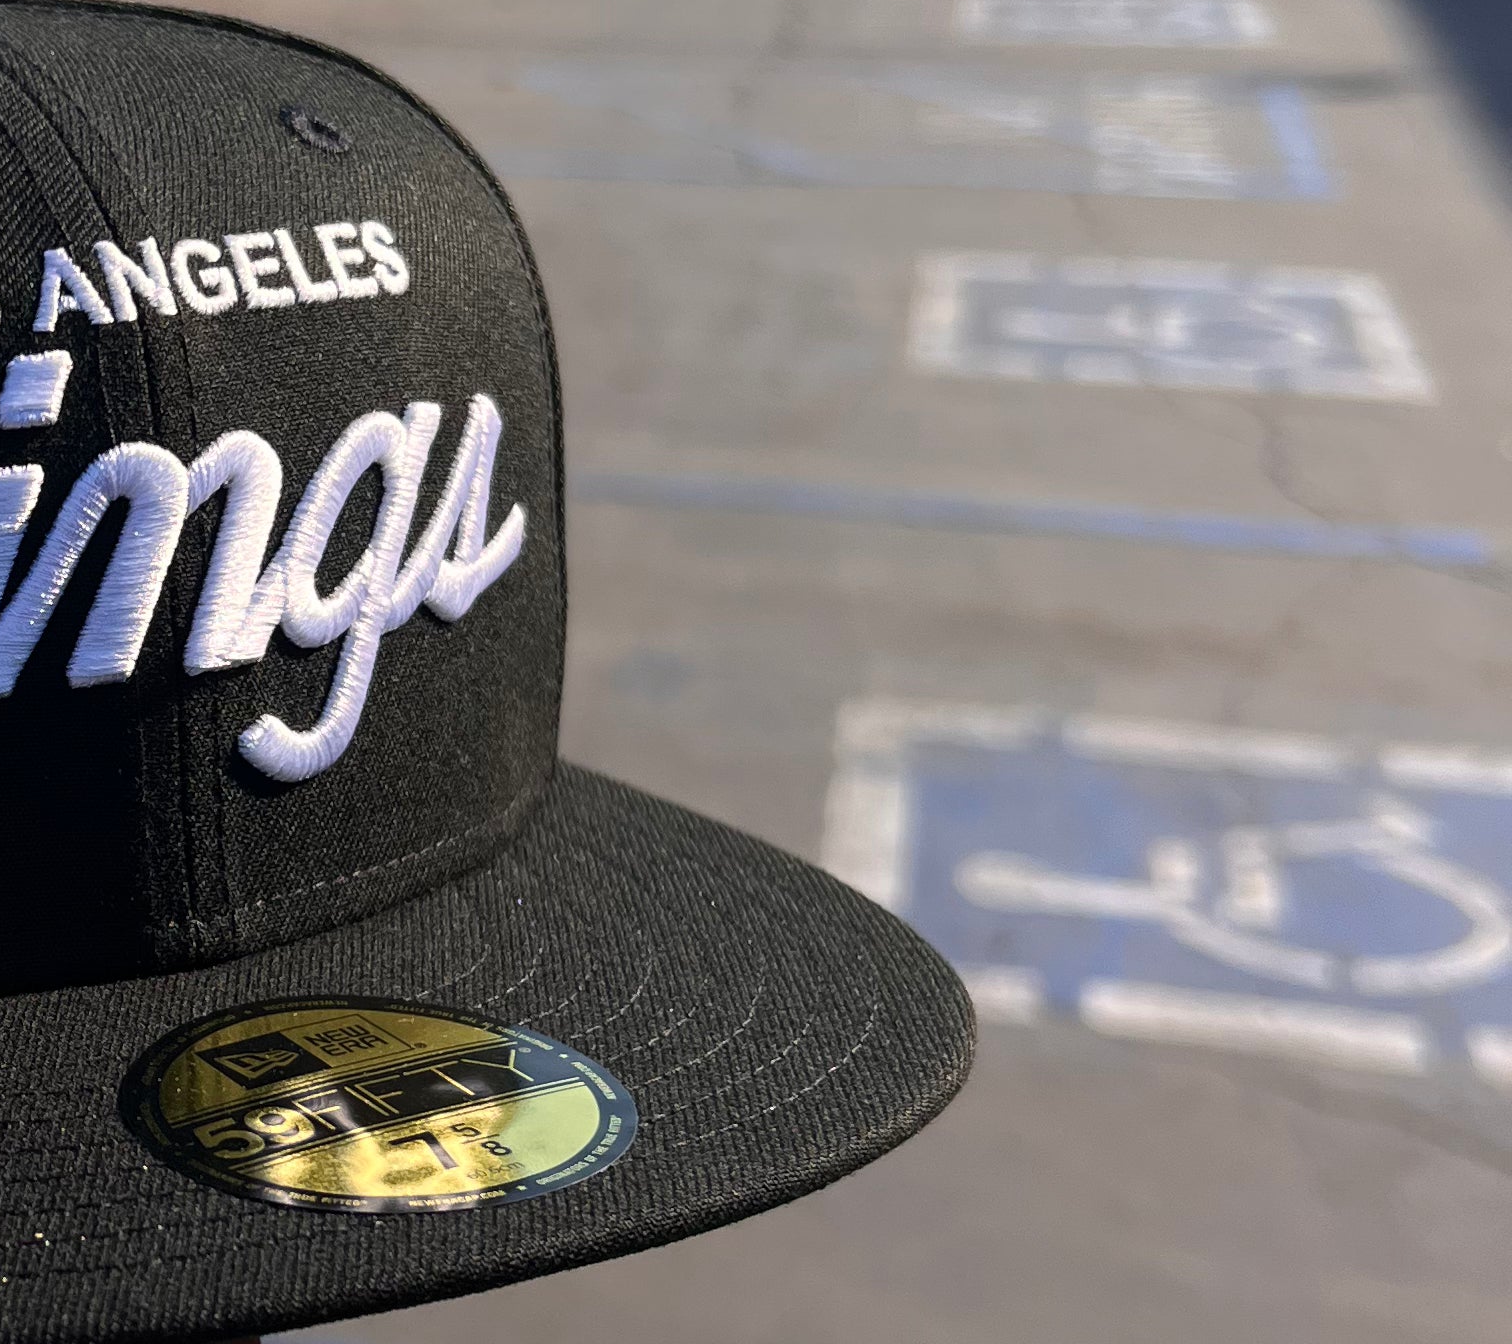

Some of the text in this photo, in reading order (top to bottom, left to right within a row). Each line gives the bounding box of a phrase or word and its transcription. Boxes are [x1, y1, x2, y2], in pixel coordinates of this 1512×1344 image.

[33, 221, 410, 333] ANGELES
[303, 1022, 371, 1047] NEW
[321, 1033, 389, 1057] ERA
[388, 1130, 459, 1170] 7
